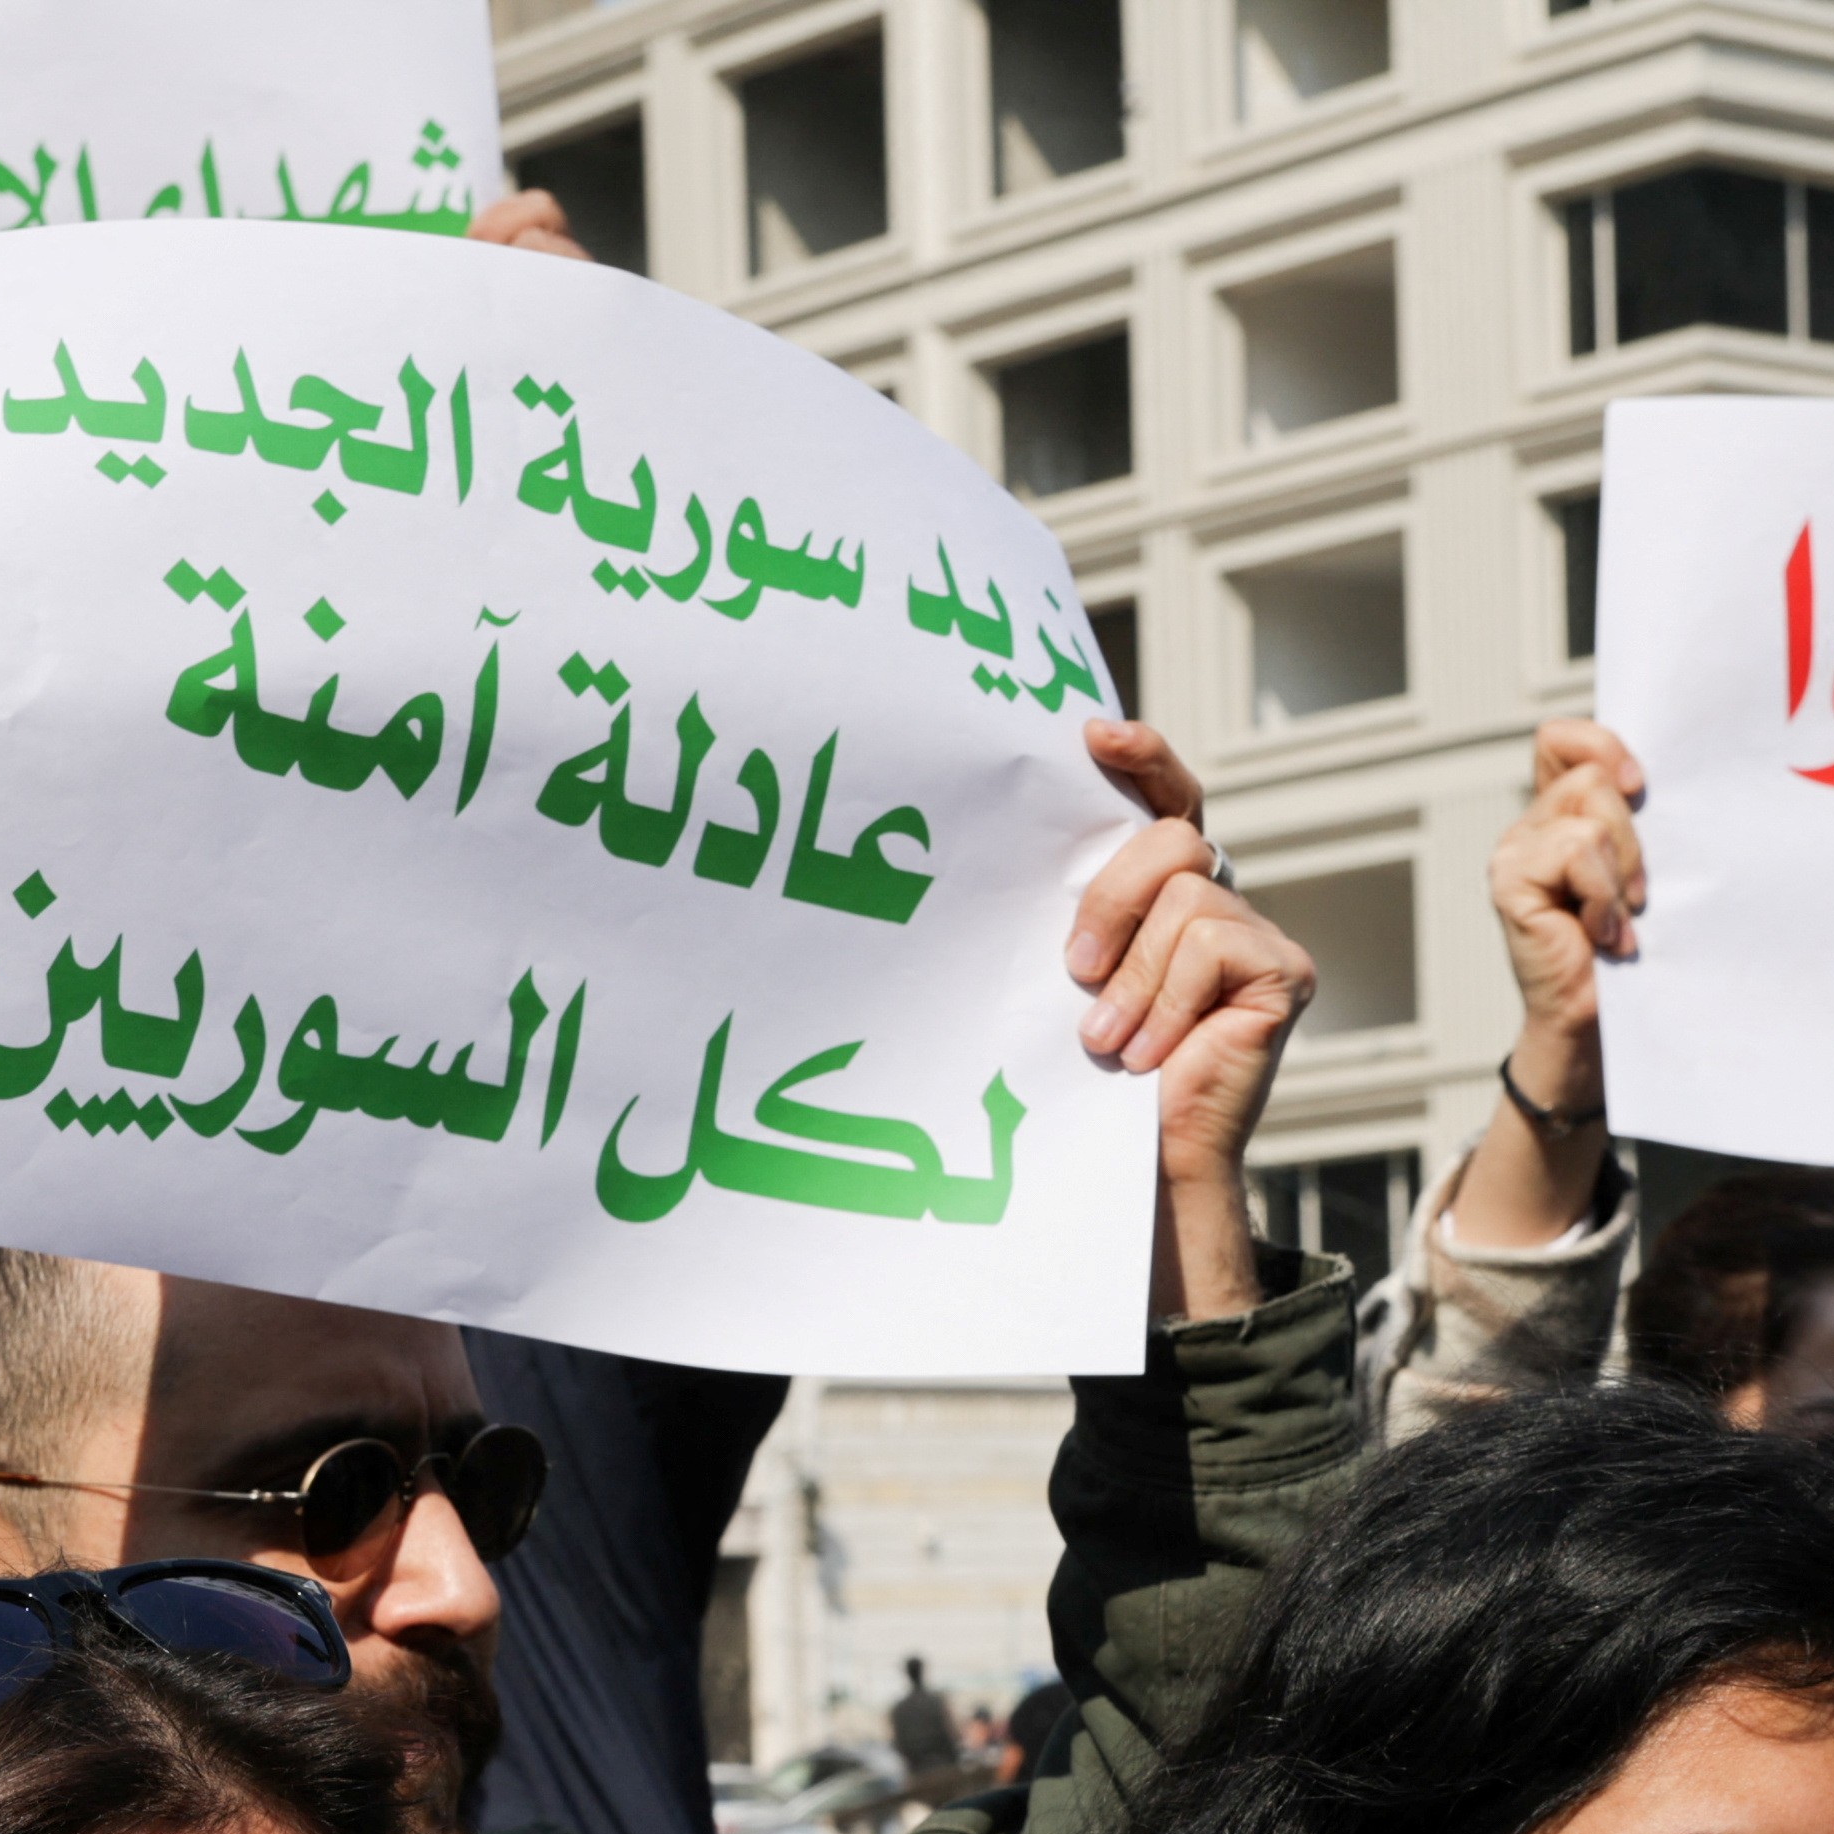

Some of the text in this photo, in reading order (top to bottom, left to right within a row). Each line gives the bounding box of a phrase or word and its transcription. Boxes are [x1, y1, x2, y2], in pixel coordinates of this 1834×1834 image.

[514, 373, 865, 622] سورية
[907, 532, 1104, 713] نريد
[163, 556, 935, 926] عادلة آمنة
[595, 1008, 1029, 1225] لكل
